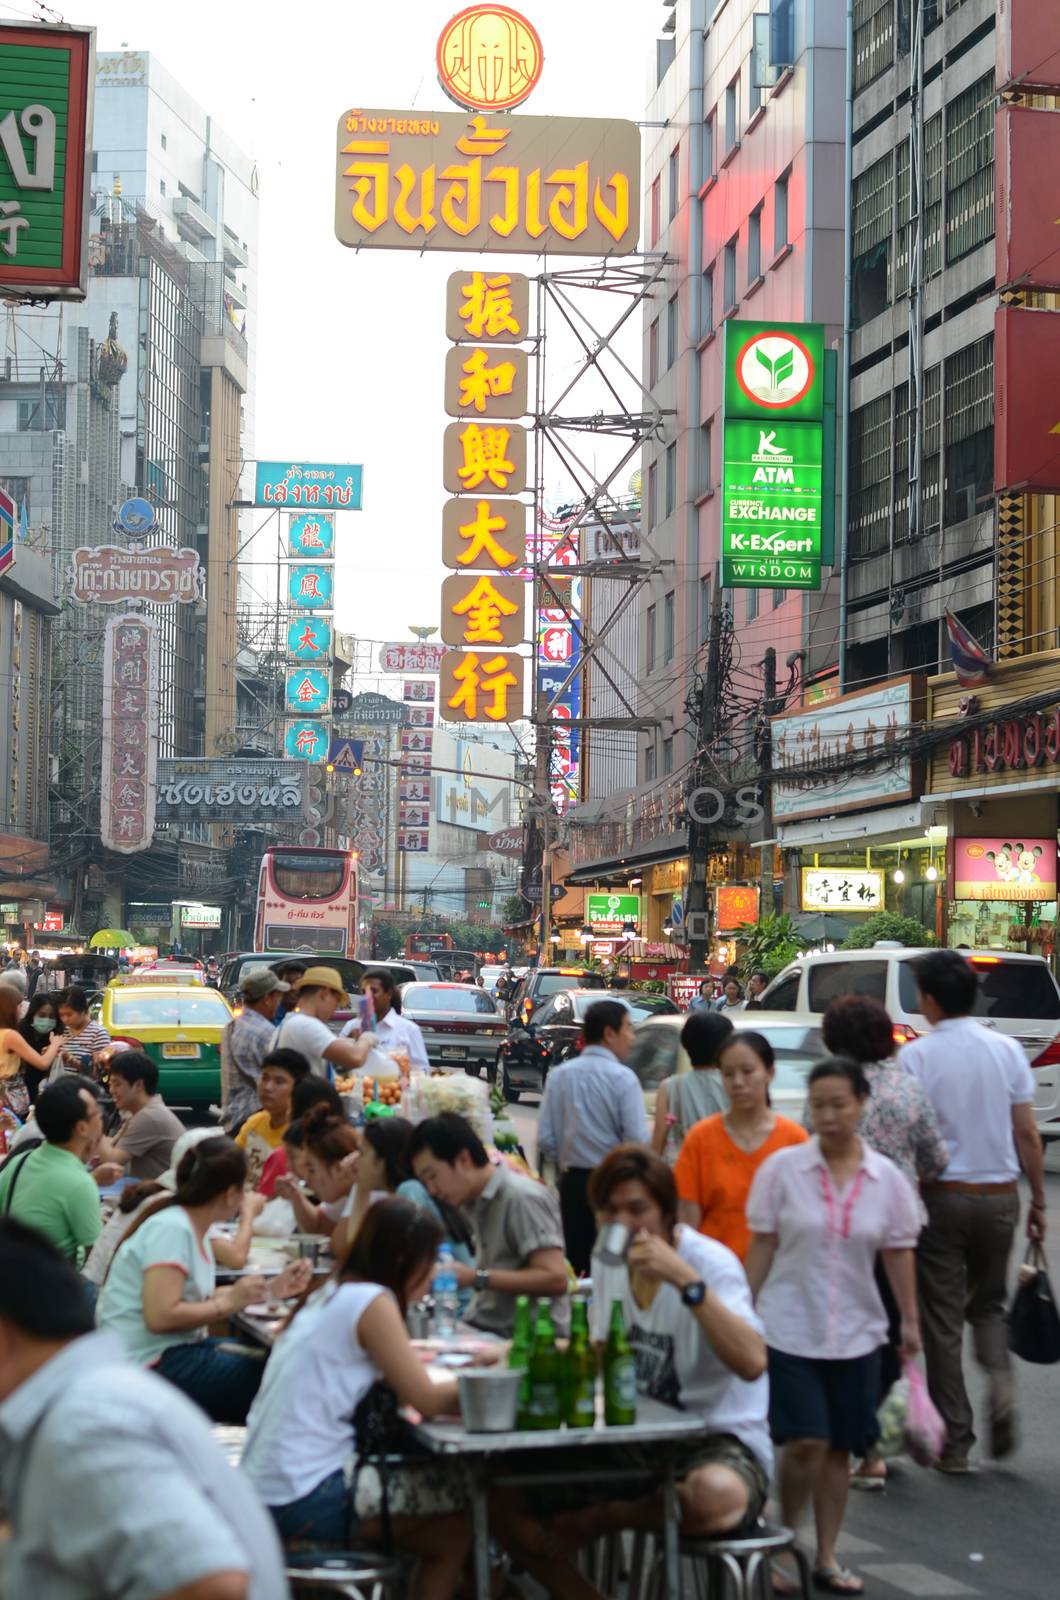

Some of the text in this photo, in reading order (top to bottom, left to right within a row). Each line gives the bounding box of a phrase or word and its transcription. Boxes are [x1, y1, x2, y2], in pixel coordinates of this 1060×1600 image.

[345, 109, 440, 137] ห้างขายทอง
[340, 115, 630, 243] จินฮั้วเฮง
[752, 467, 795, 484] ATM
[264, 476, 353, 505] เล่งหงษ์
[447, 271, 521, 722] 振和興大金行
[729, 499, 764, 507] CURRENCY
[729, 506, 816, 522] EXCHANGE
[730, 530, 813, 555] K-Expert
[732, 564, 812, 578] WISDOM
[295, 523, 324, 757] 龍鳳大金行
